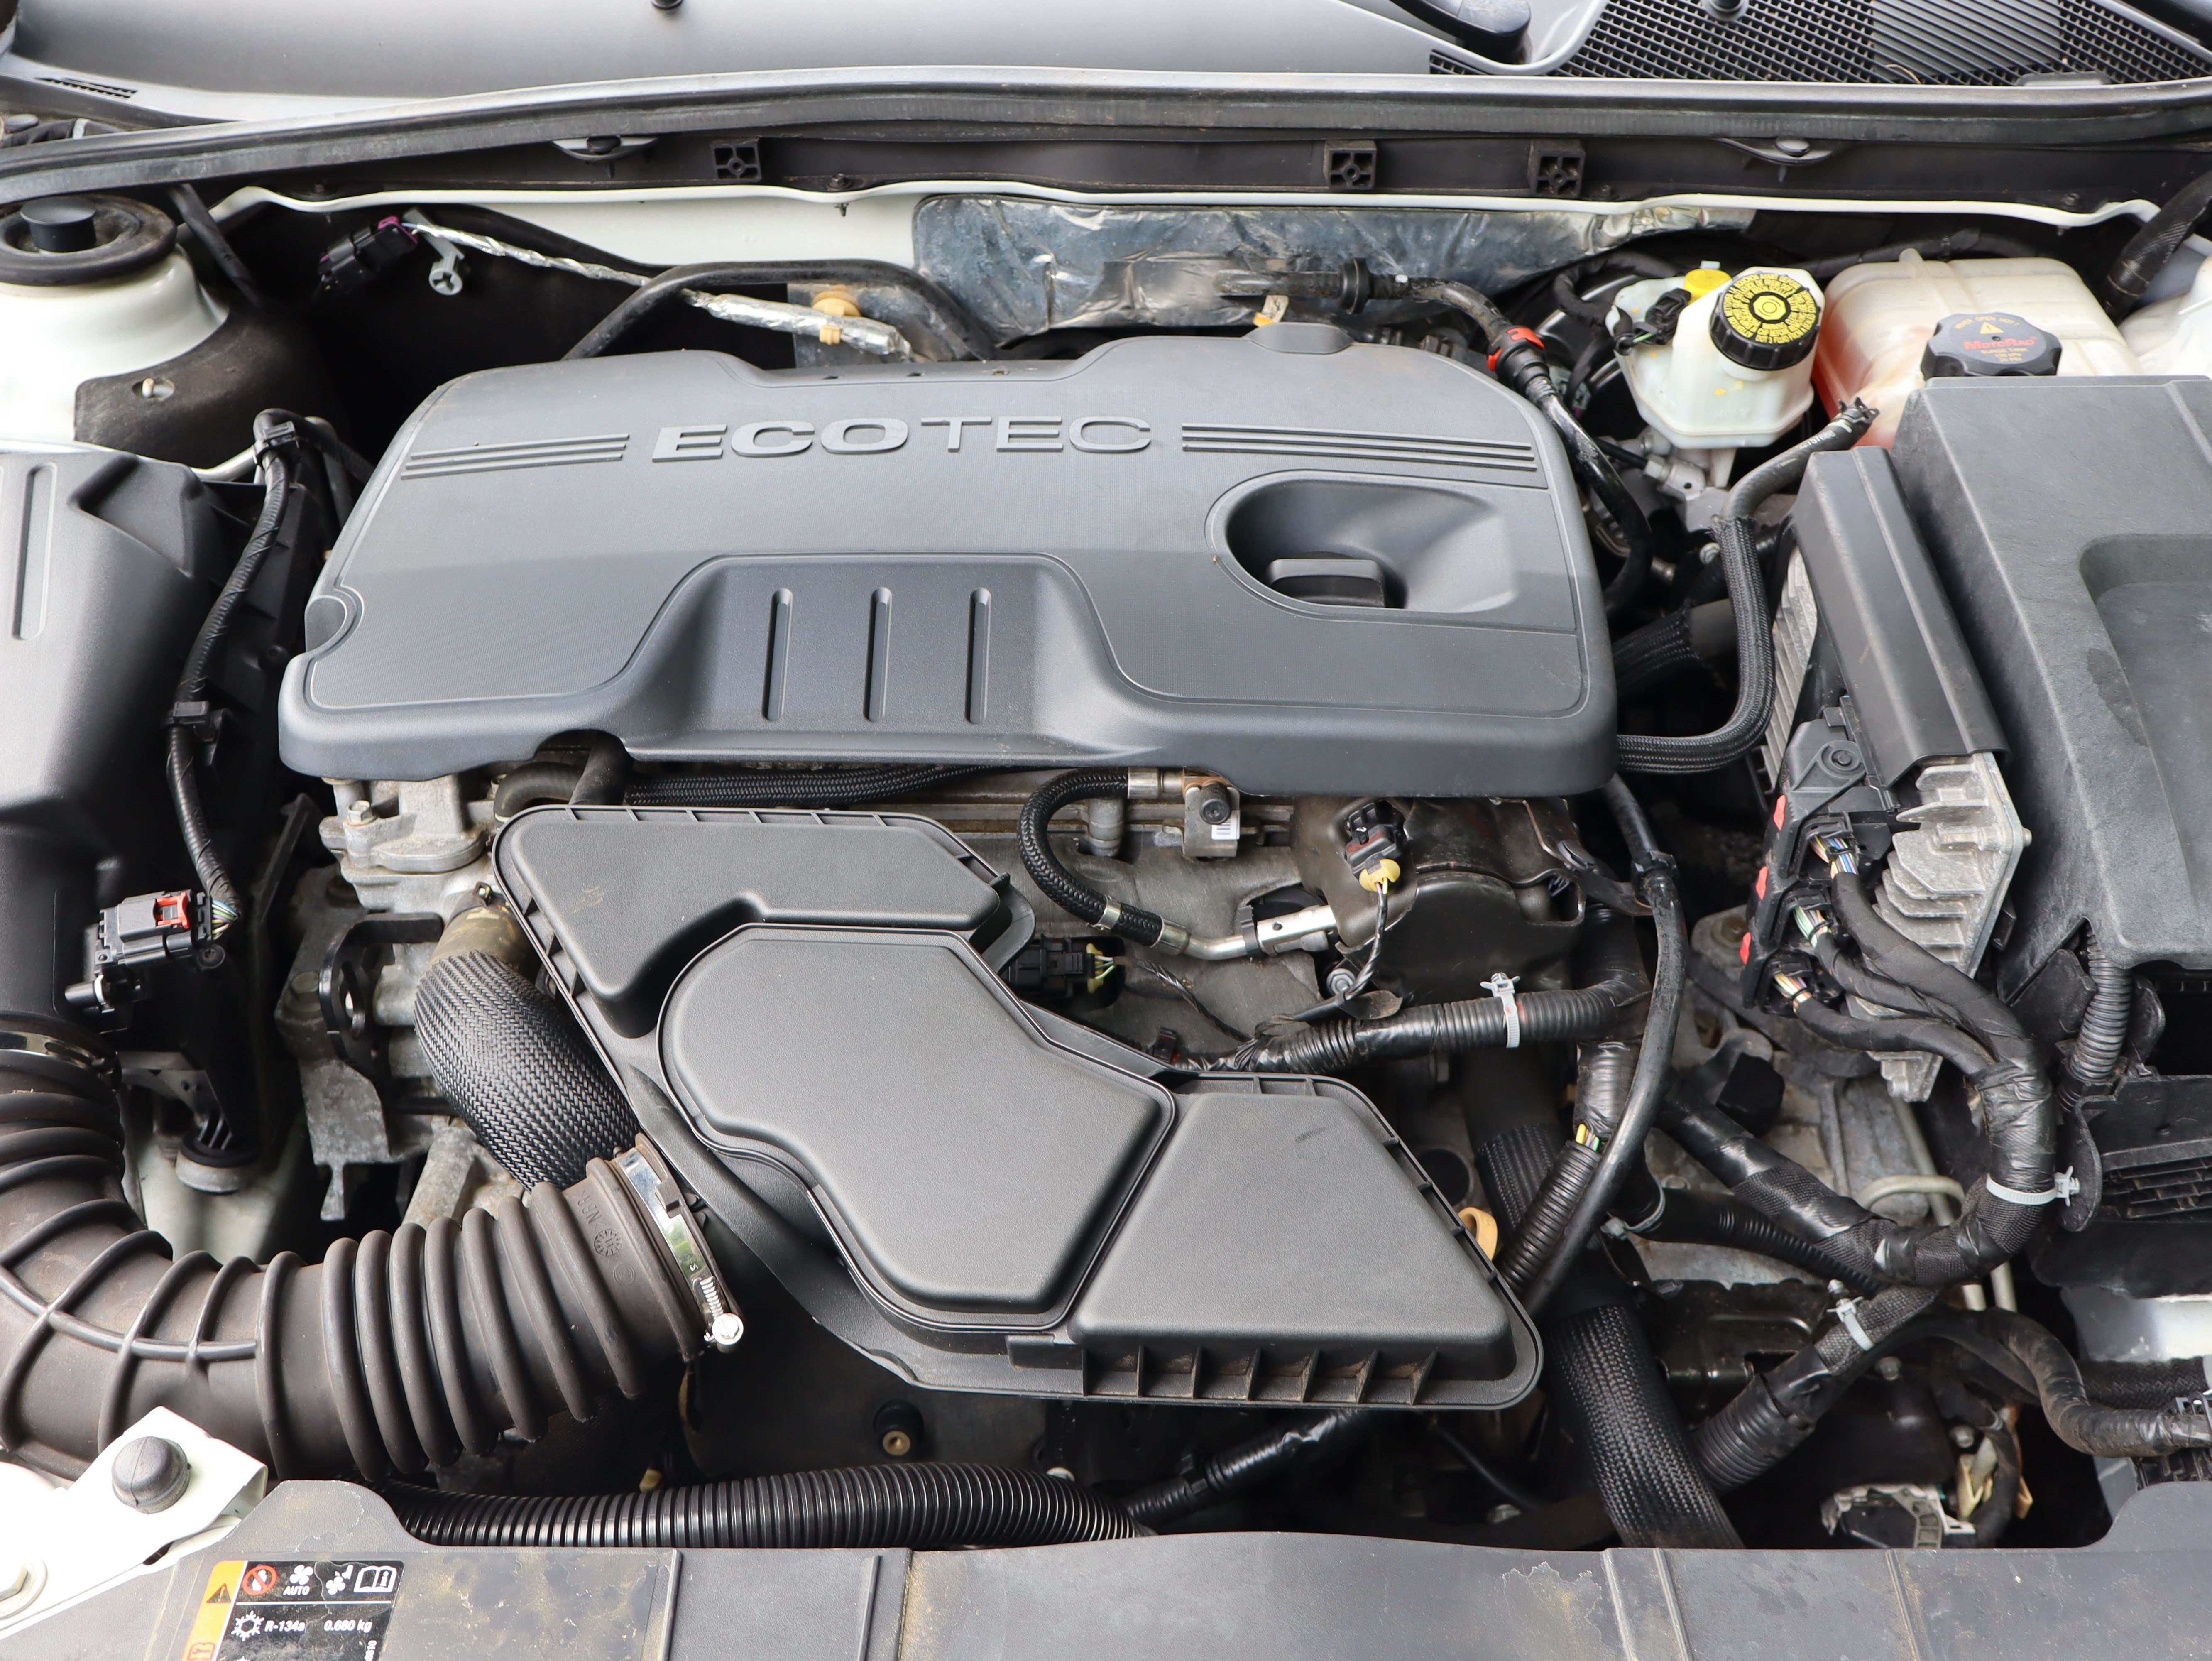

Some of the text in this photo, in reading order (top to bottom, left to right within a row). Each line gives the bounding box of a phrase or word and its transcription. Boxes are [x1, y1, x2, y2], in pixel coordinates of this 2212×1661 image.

[652, 415, 1150, 463] ECOTEC
[283, 1585, 310, 1596] AUTO
[264, 1619, 372, 1633] R-134a 0.680 kg
